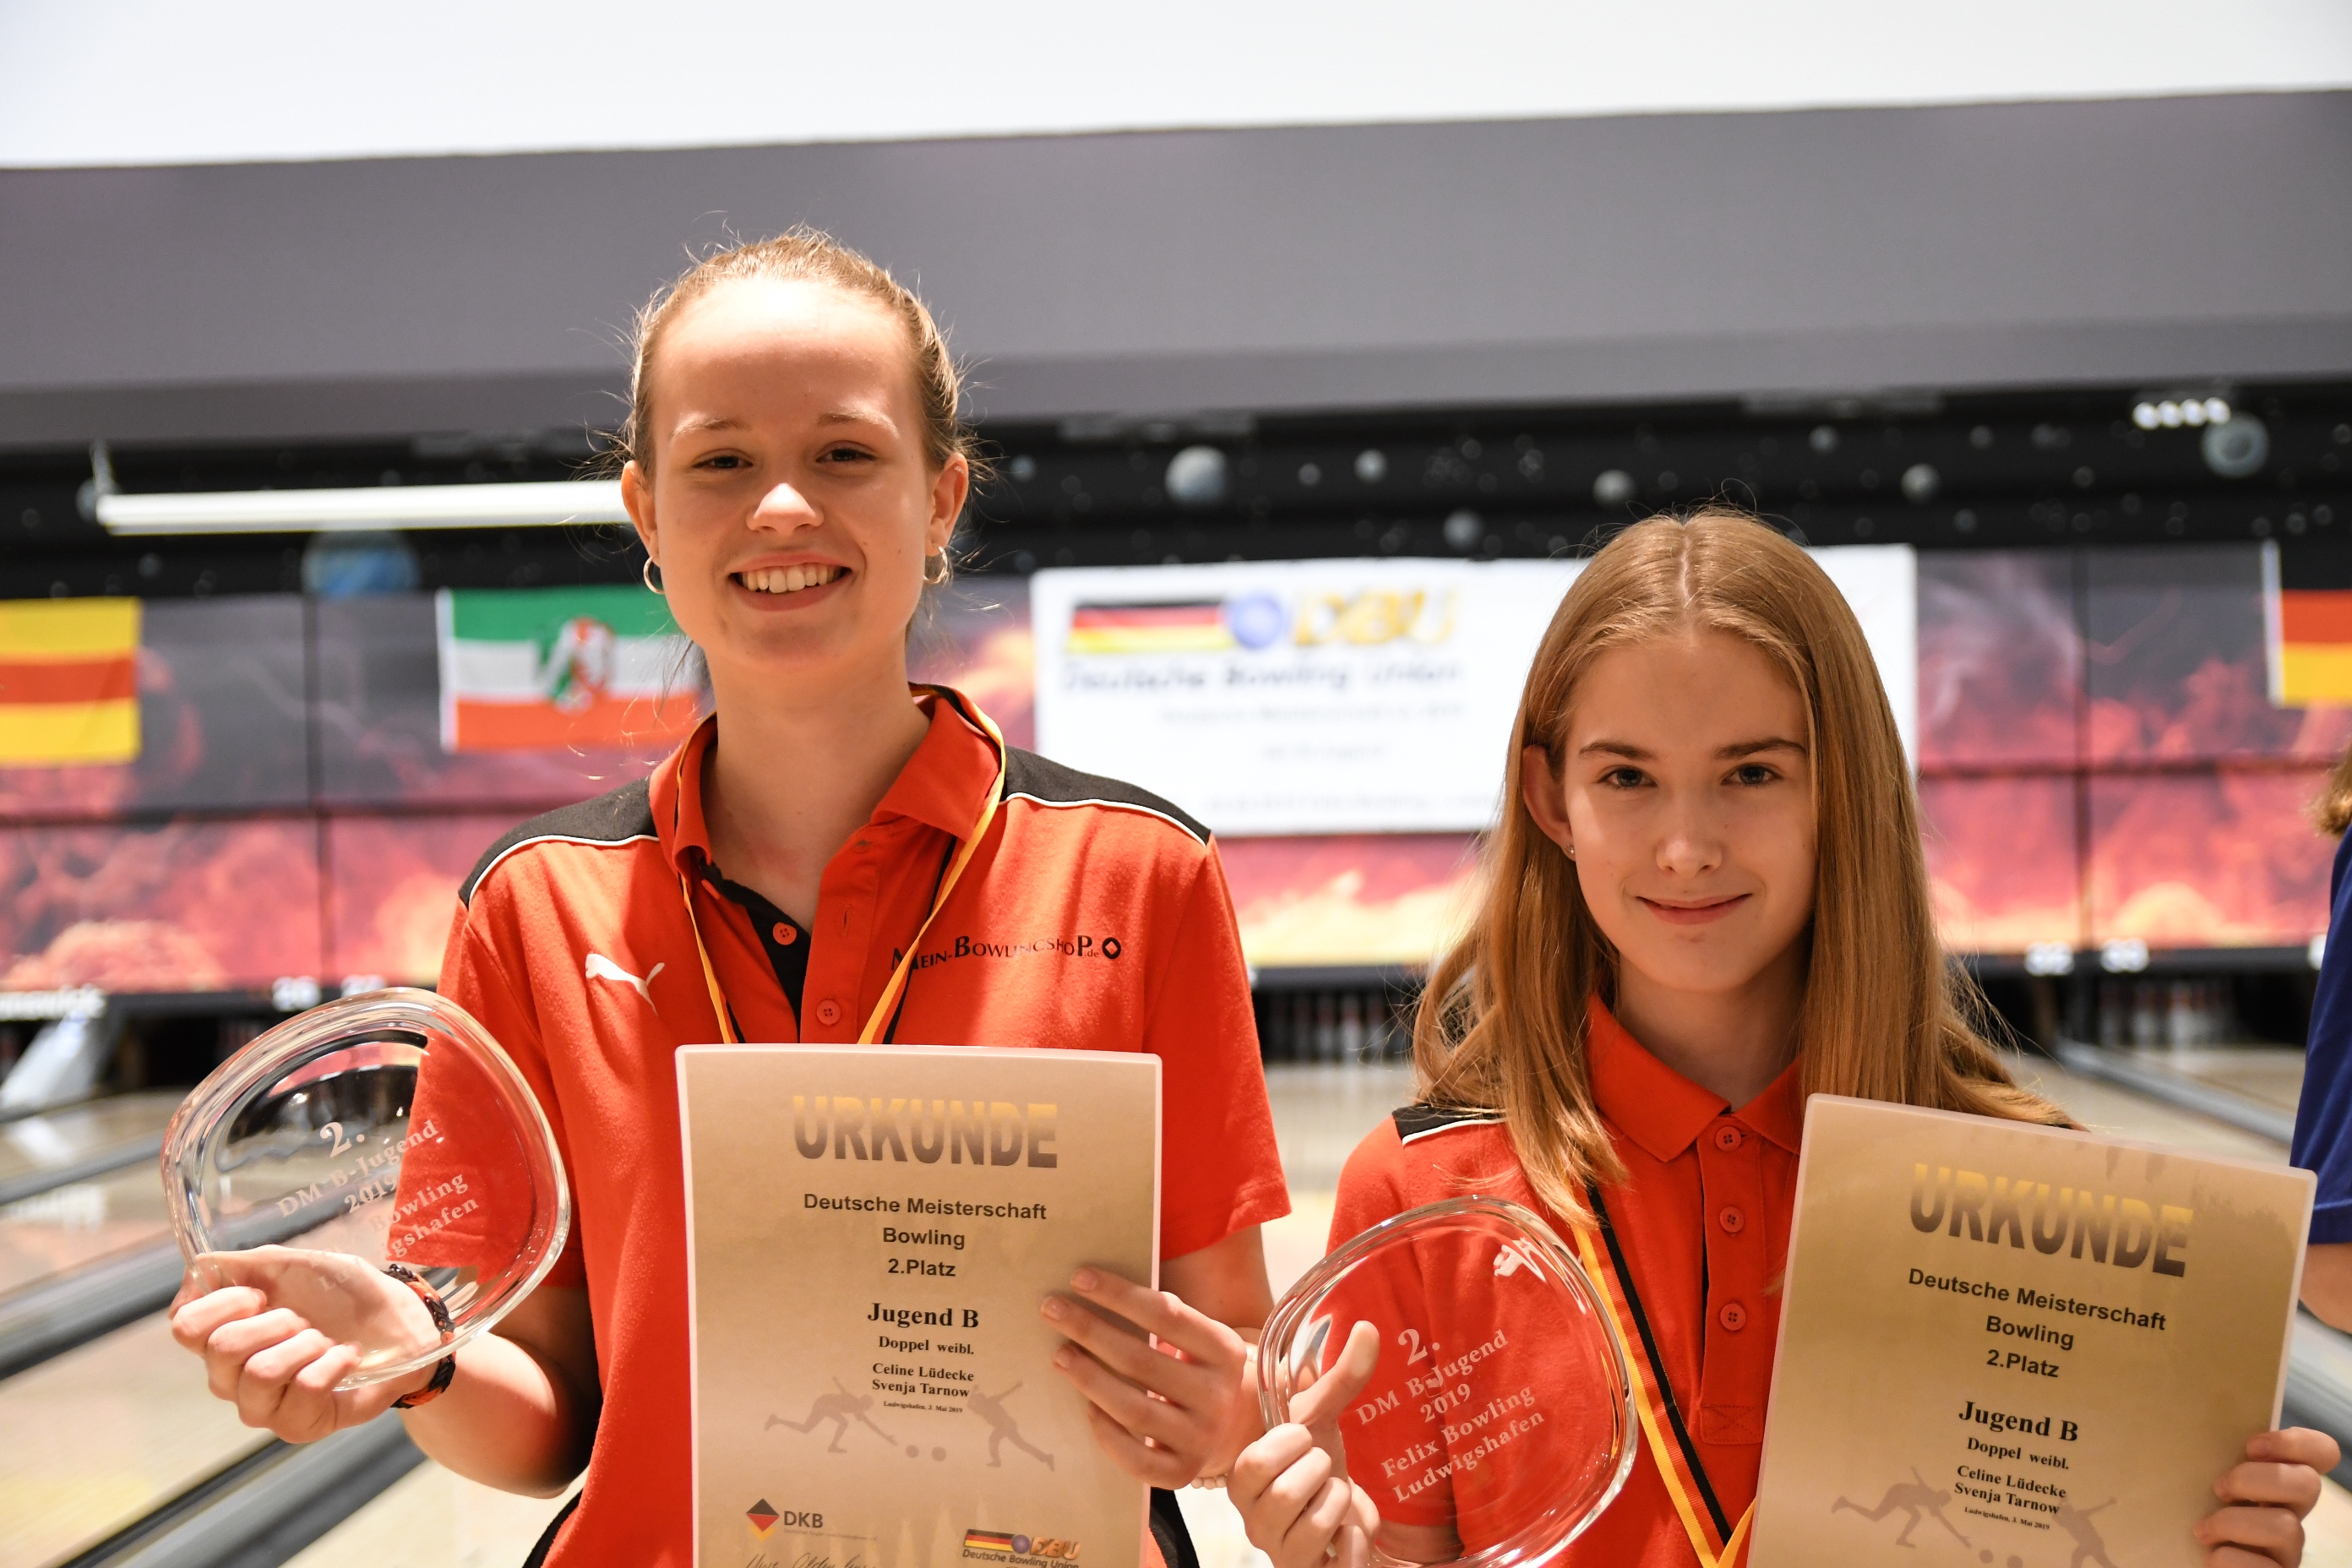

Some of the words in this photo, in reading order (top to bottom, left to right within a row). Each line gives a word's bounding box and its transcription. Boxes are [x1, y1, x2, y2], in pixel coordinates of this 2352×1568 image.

[319, 1121, 365, 1158] 2.
[793, 1095, 1058, 1168] URKUNDE
[276, 1184, 323, 1218] DM
[329, 1119, 439, 1188] B-Jugend
[344, 1173, 398, 1213] 2019
[804, 1193, 900, 1212] Deutsche
[907, 1197, 1047, 1220] Meisterschaft
[1909, 1162, 2194, 1278] URKUNDE
[883, 1227, 965, 1250] Bowling
[888, 1258, 956, 1277] 2.Platz
[1908, 1267, 2010, 1301] Deutsche
[2017, 1288, 2166, 1330] Meisterschaft
[868, 1303, 953, 1328] Jugend
[961, 1309, 979, 1328] B
[879, 1336, 929, 1353] Doppel
[937, 1343, 974, 1354] weibl.
[1397, 1328, 1440, 1365] 2.
[1986, 1315, 2074, 1350] Bowling
[873, 1363, 914, 1376] Celine
[919, 1366, 974, 1381] Lüdecke
[1986, 1349, 2060, 1378] 2.Platz
[872, 1379, 916, 1395] Svenja
[920, 1383, 970, 1397] Tarnow
[1420, 1383, 1471, 1424] 2019
[1356, 1390, 1401, 1425] DM
[1958, 1401, 2051, 1436] Jugend
[2059, 1420, 2078, 1441] B
[1380, 1440, 1440, 1478] Felix
[1440, 1386, 1535, 1446] Bowling
[1392, 1412, 1544, 1503] Ludwigshafen
[1968, 1437, 2022, 1459] Doppel
[2029, 1453, 2069, 1469] weibl.
[1957, 1465, 2001, 1484] Celine
[2006, 1475, 2066, 1498] Lüdecke
[1954, 1482, 2001, 1503] Svenja
[2006, 1493, 2060, 1515] Tarnow
[783, 1511, 824, 1528] DKB
[1965, 1506, 2010, 1522] Ludwigshafen,
[2034, 1522, 2050, 1531] 2019
[962, 1549, 1006, 1563] Deutsche
[1009, 1554, 1048, 1568] Bowling
[1029, 1536, 1081, 1560] DBU
